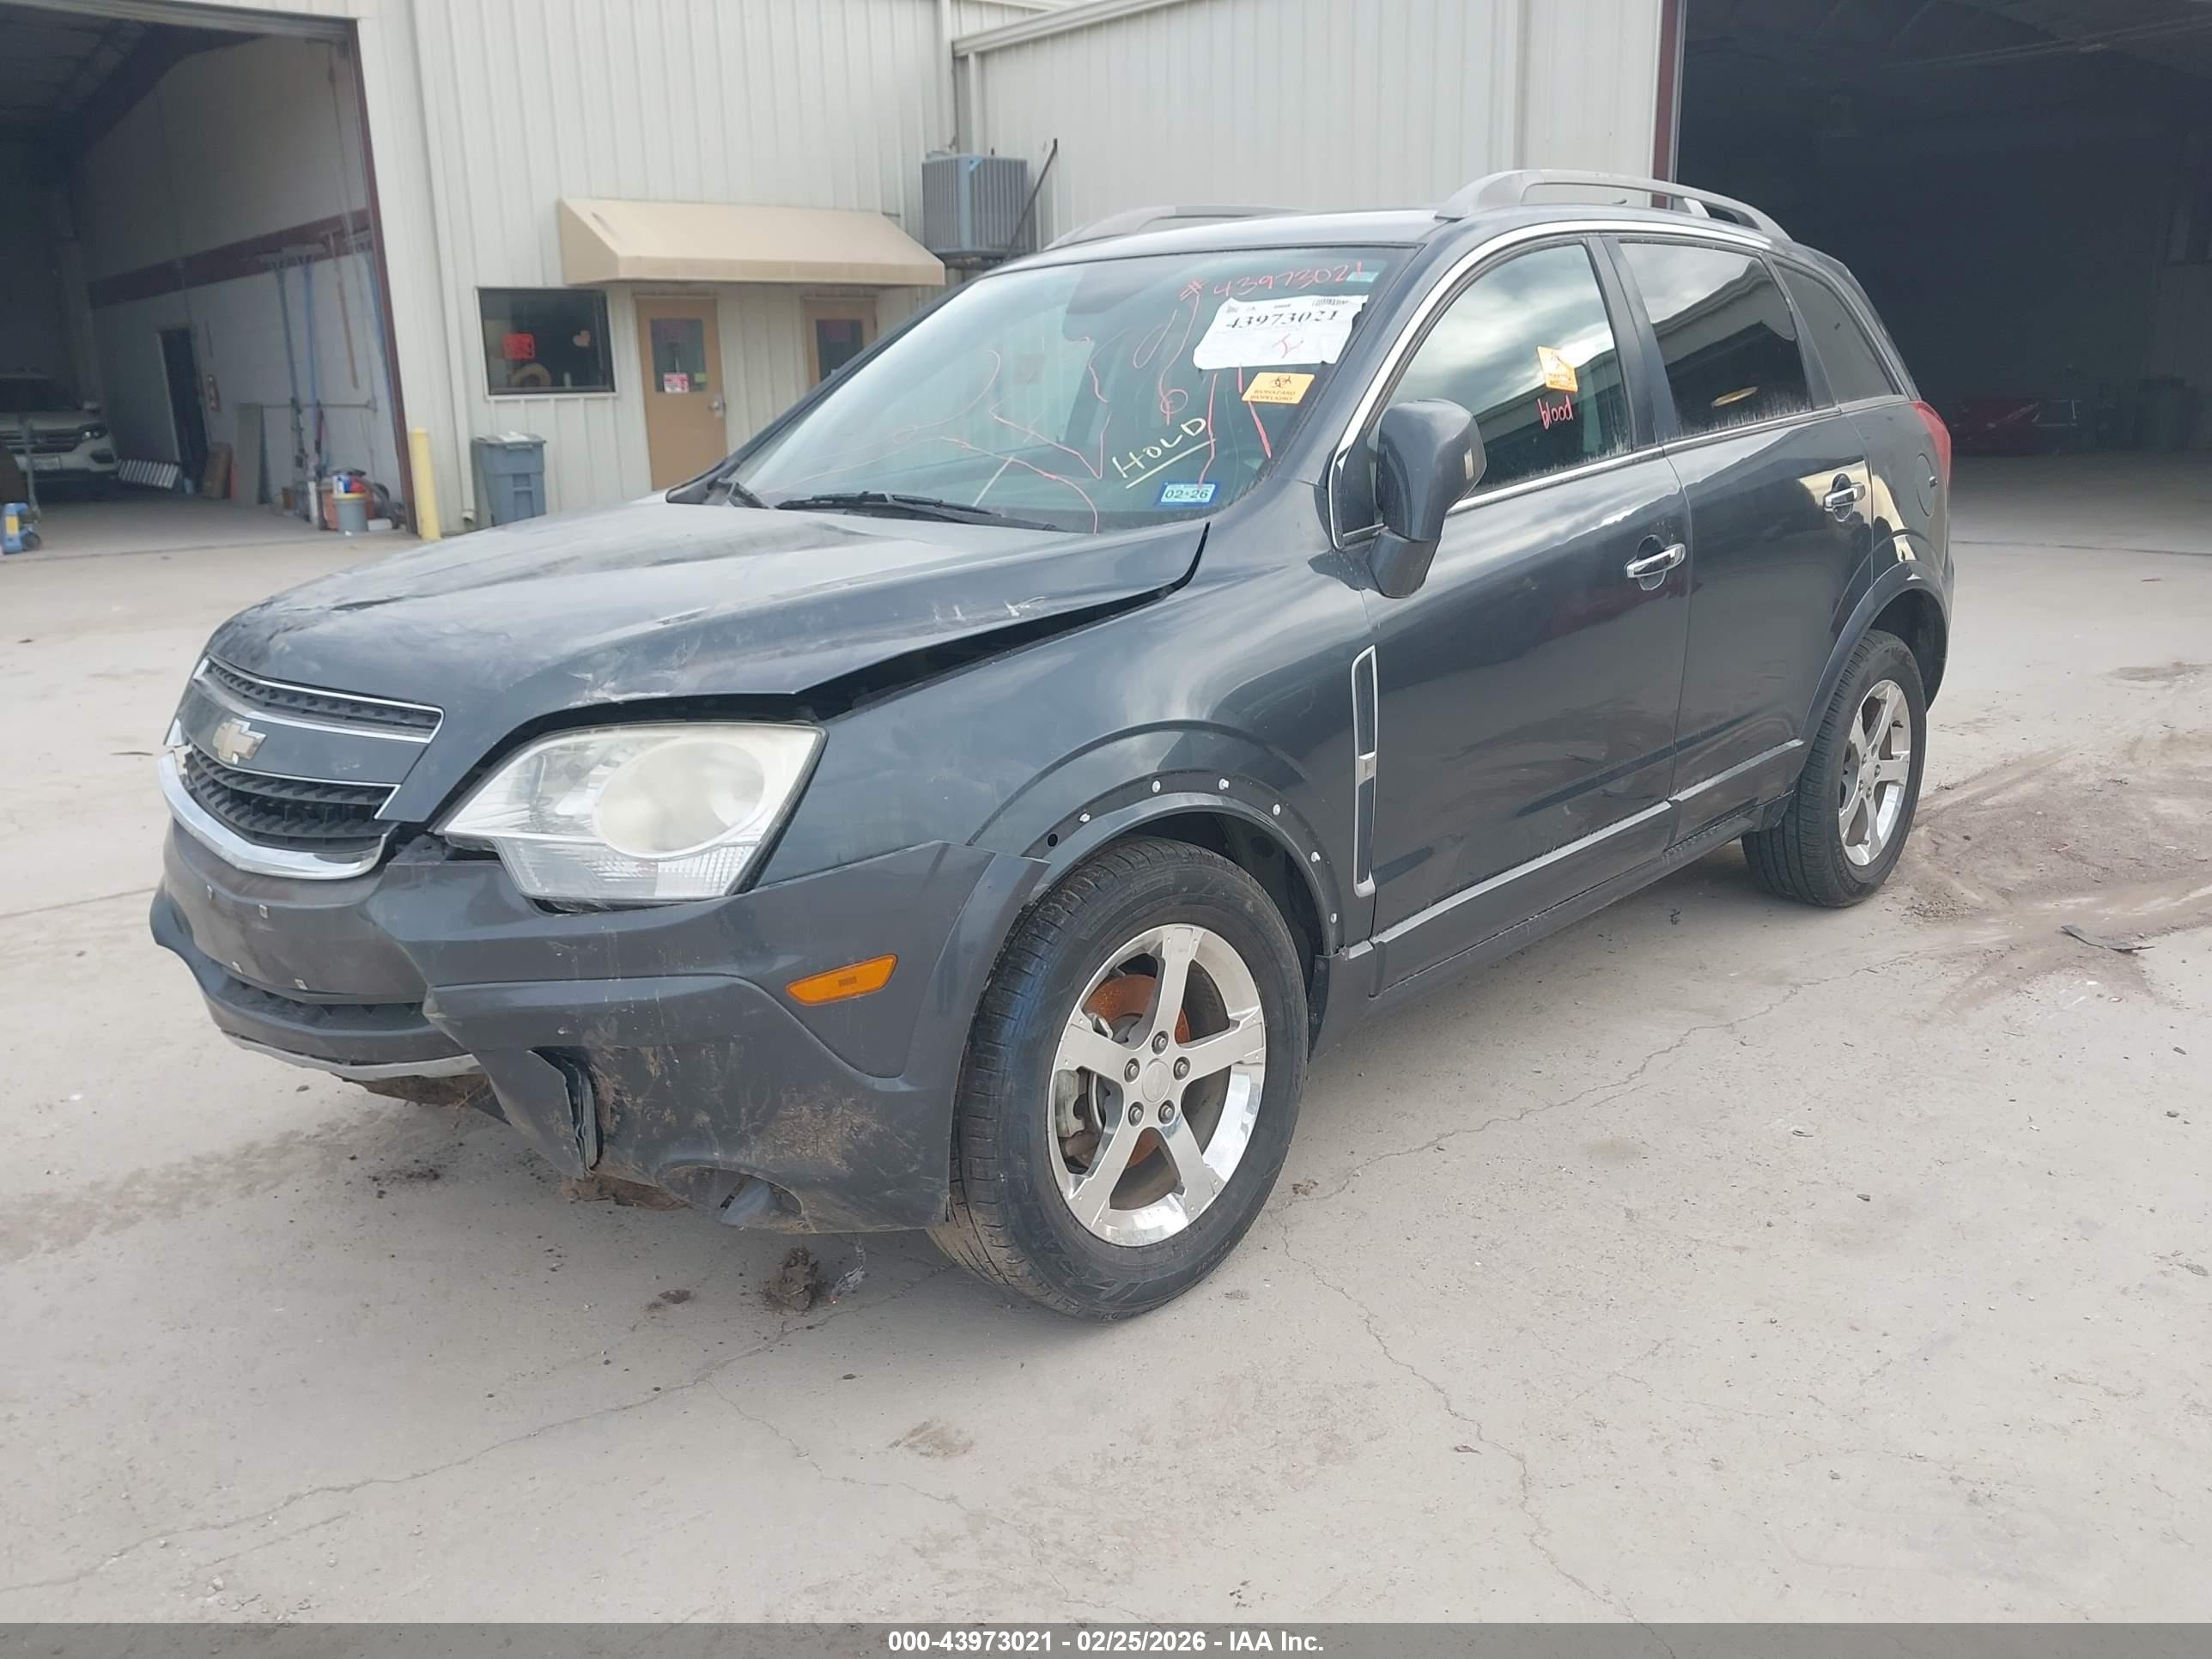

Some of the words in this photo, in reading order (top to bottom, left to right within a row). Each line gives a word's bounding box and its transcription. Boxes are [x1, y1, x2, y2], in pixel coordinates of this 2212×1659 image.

[1226, 310, 1338, 329] 43973021
[1538, 394, 1574, 430] blood
[1112, 417, 1206, 478] HOLD
